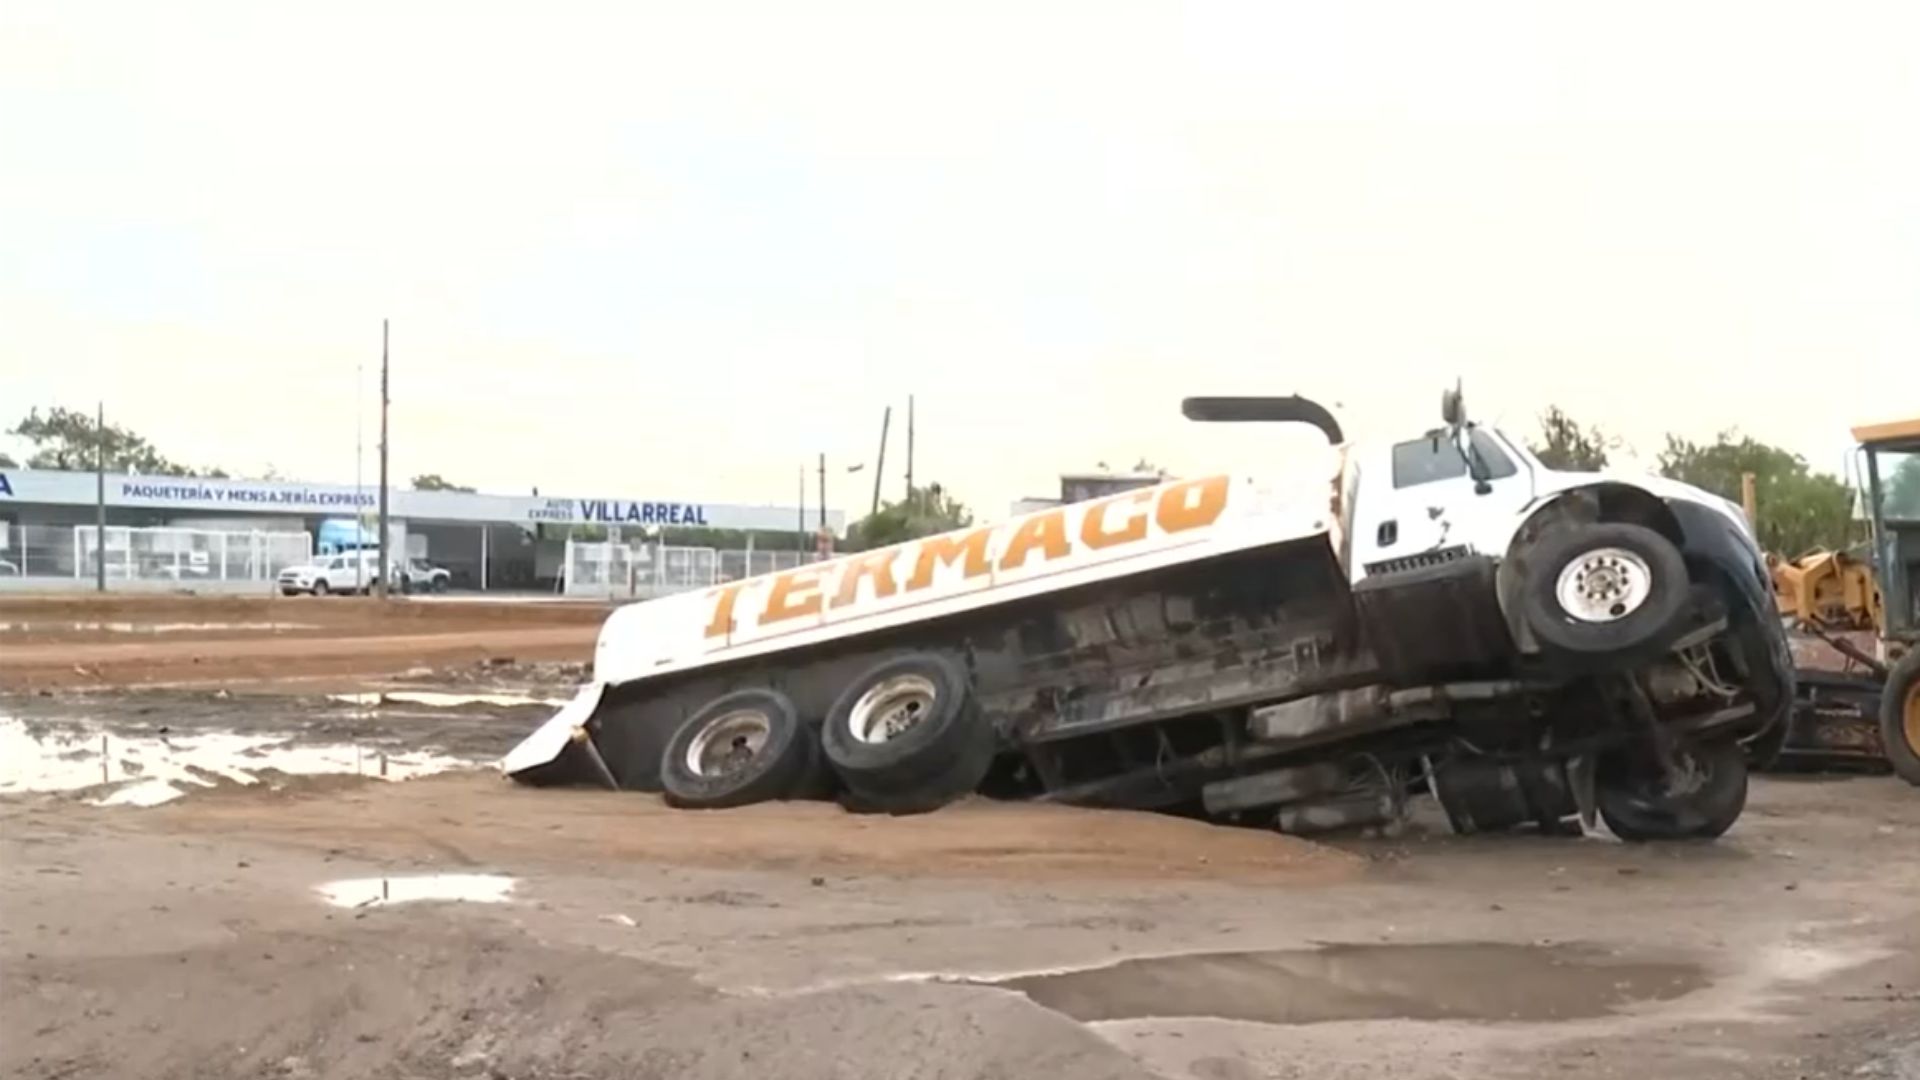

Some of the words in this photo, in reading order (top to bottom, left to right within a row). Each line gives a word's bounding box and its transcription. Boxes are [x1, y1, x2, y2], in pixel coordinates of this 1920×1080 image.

[123, 483, 213, 501] PAQUETERÍA
[214, 488, 225, 500] Y
[227, 487, 317, 504] MENSAJERÍA
[319, 491, 376, 506] EXPRESS
[580, 500, 708, 525] VILLARREAL
